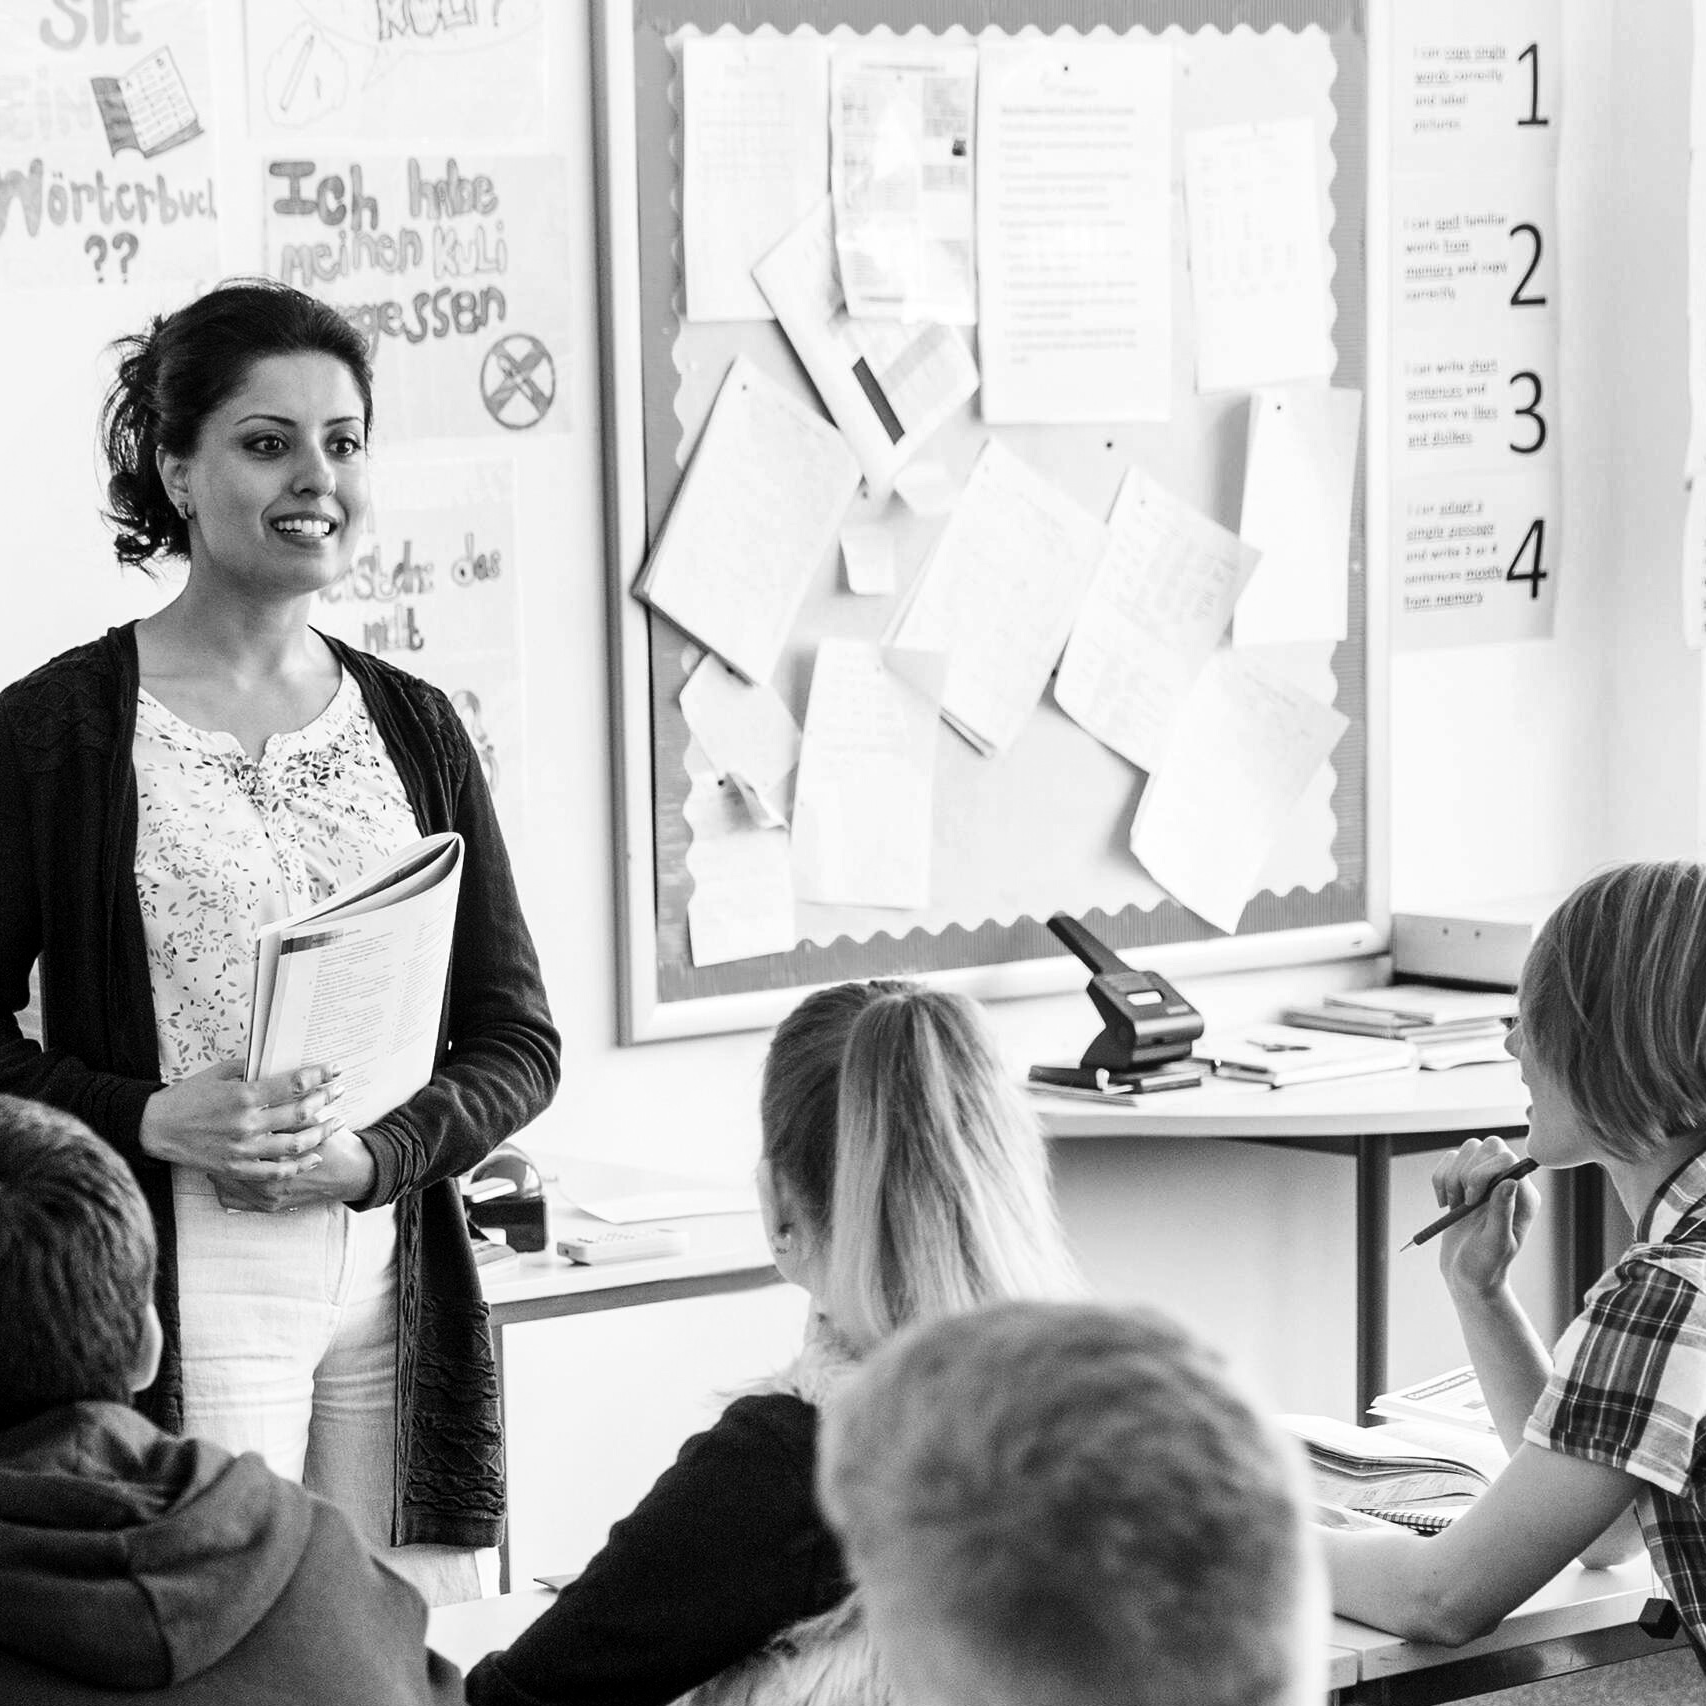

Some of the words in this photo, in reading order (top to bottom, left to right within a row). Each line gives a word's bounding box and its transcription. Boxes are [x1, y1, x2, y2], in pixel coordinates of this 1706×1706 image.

[1516, 41, 1550, 128] 1
[268, 160, 381, 232] Ich
[1508, 222, 1548, 307] 2
[1508, 369, 1548, 455] 3
[450, 531, 502, 588] das
[1505, 517, 1550, 602] 4
